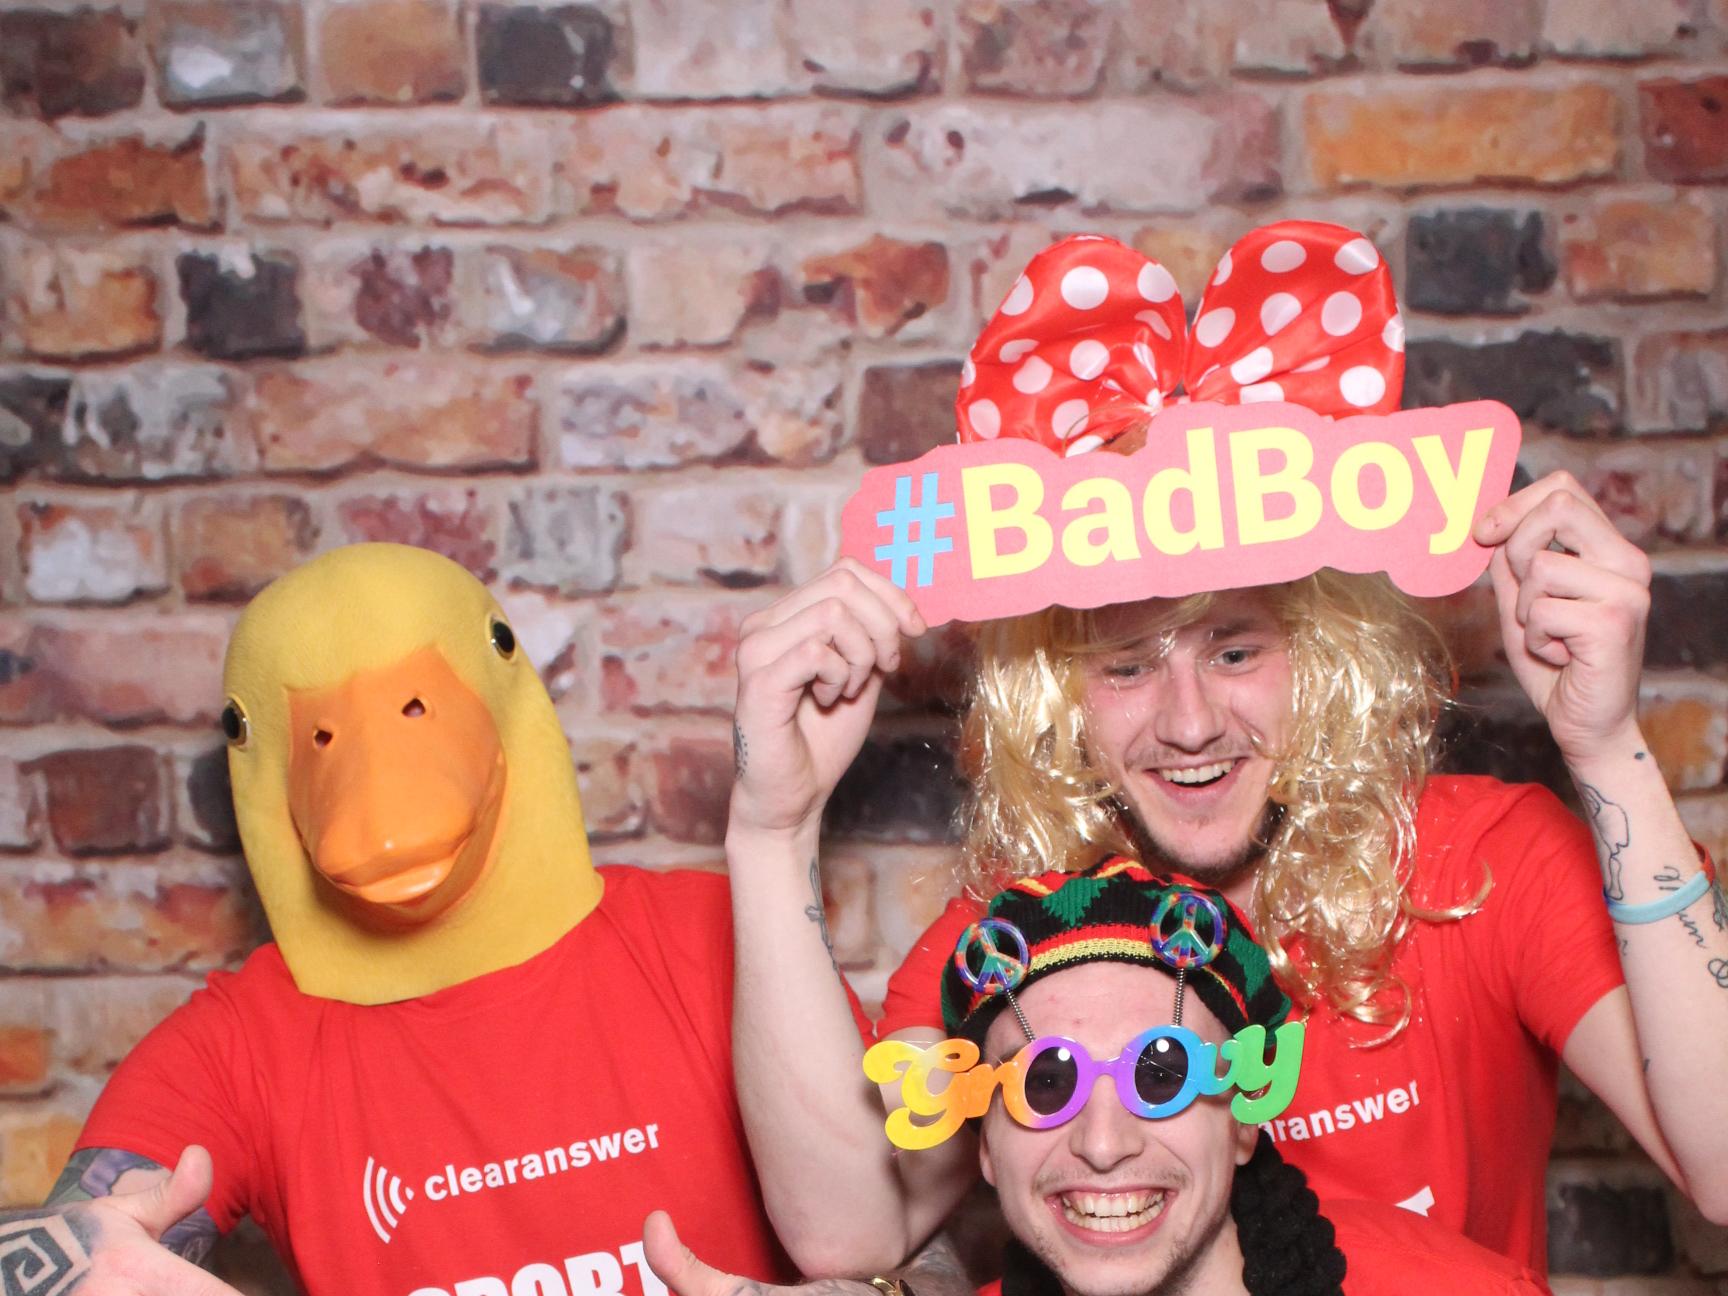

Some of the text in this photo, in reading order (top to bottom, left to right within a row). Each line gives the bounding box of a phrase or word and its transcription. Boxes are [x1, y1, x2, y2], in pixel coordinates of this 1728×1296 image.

[876, 426, 1495, 588] #BadBoy
[1258, 1081, 1420, 1142] ranswer
[424, 1123, 659, 1201] clearanswer
